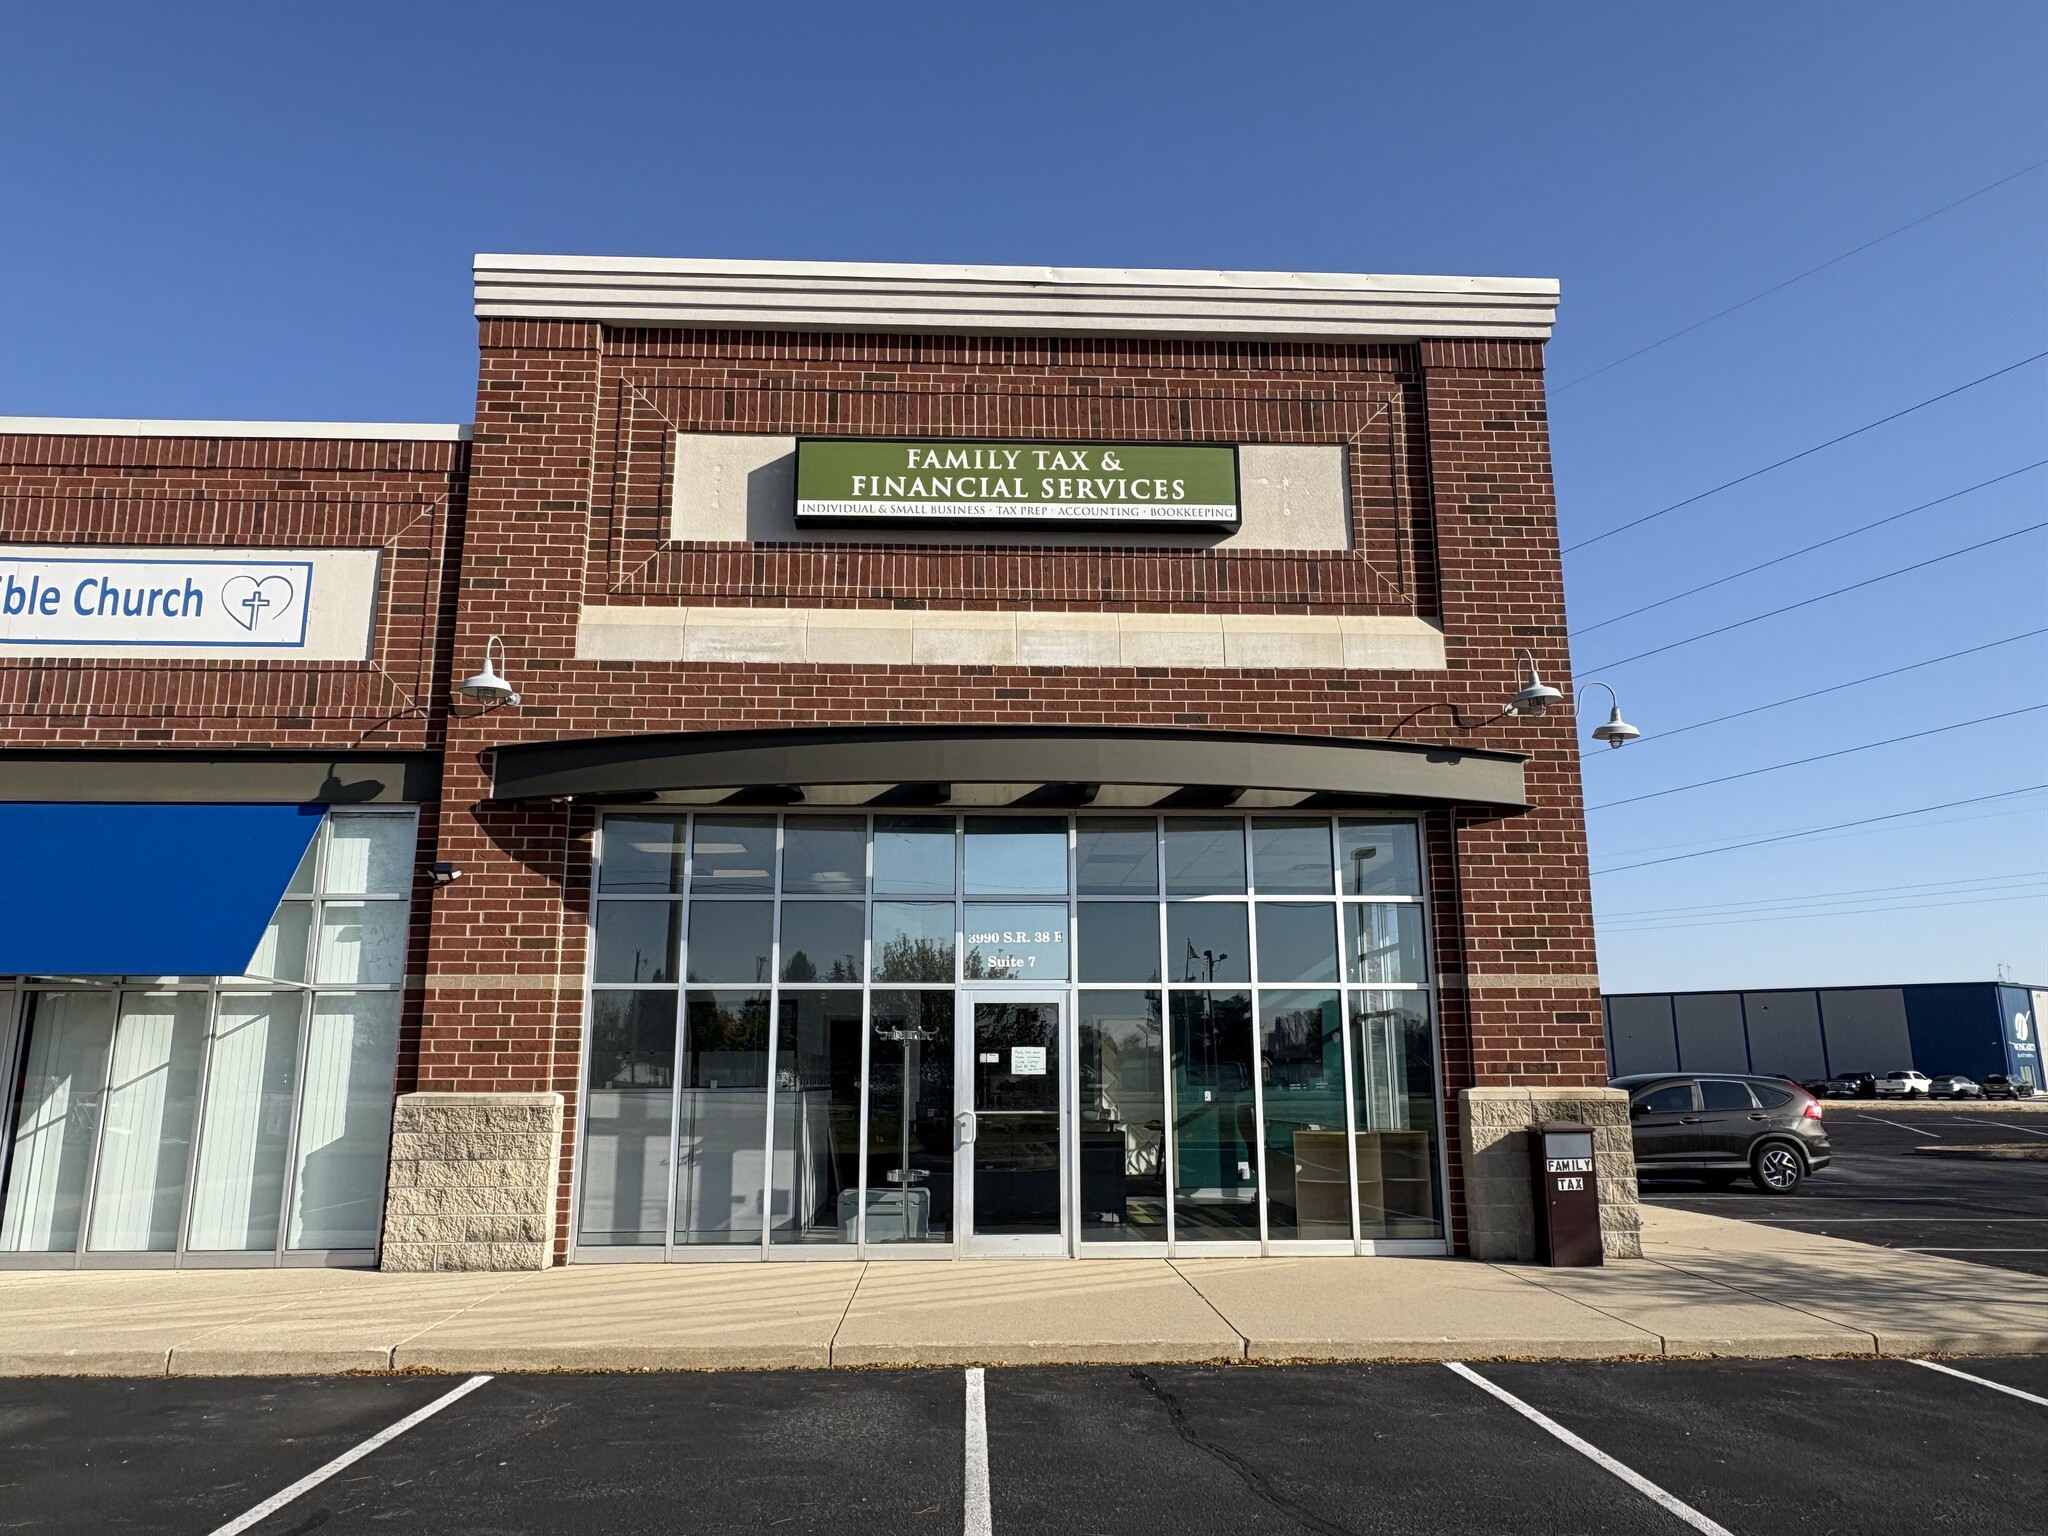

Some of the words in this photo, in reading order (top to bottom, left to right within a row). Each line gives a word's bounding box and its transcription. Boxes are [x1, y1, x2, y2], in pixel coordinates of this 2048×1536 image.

[906, 449, 1022, 470] FAMILY
[1031, 450, 1090, 471] TAX
[1100, 451, 1124, 471] &
[851, 475, 1029, 499] FINANCIAL
[1041, 478, 1186, 500] SERVICES
[802, 504, 873, 514] INDIVIDUAL
[878, 504, 888, 514] &
[890, 505, 926, 515] SMALL
[931, 505, 986, 515] BUSINESS
[996, 506, 1018, 515] TAX
[1020, 506, 1048, 516] PREP
[1057, 507, 1140, 517] ACCOUNTING
[1150, 507, 1234, 518] BOOKKEEPING
[0, 574, 61, 616] ble
[73, 576, 204, 618] Church
[968, 932, 1000, 944] 3990
[1003, 931, 1031, 943] S.R.
[1034, 931, 1051, 943] 38
[987, 955, 1024, 967] Suite
[1028, 956, 1036, 967] 7
[1548, 1160, 1590, 1171] FAMILY
[1558, 1179, 1582, 1190] TAX
